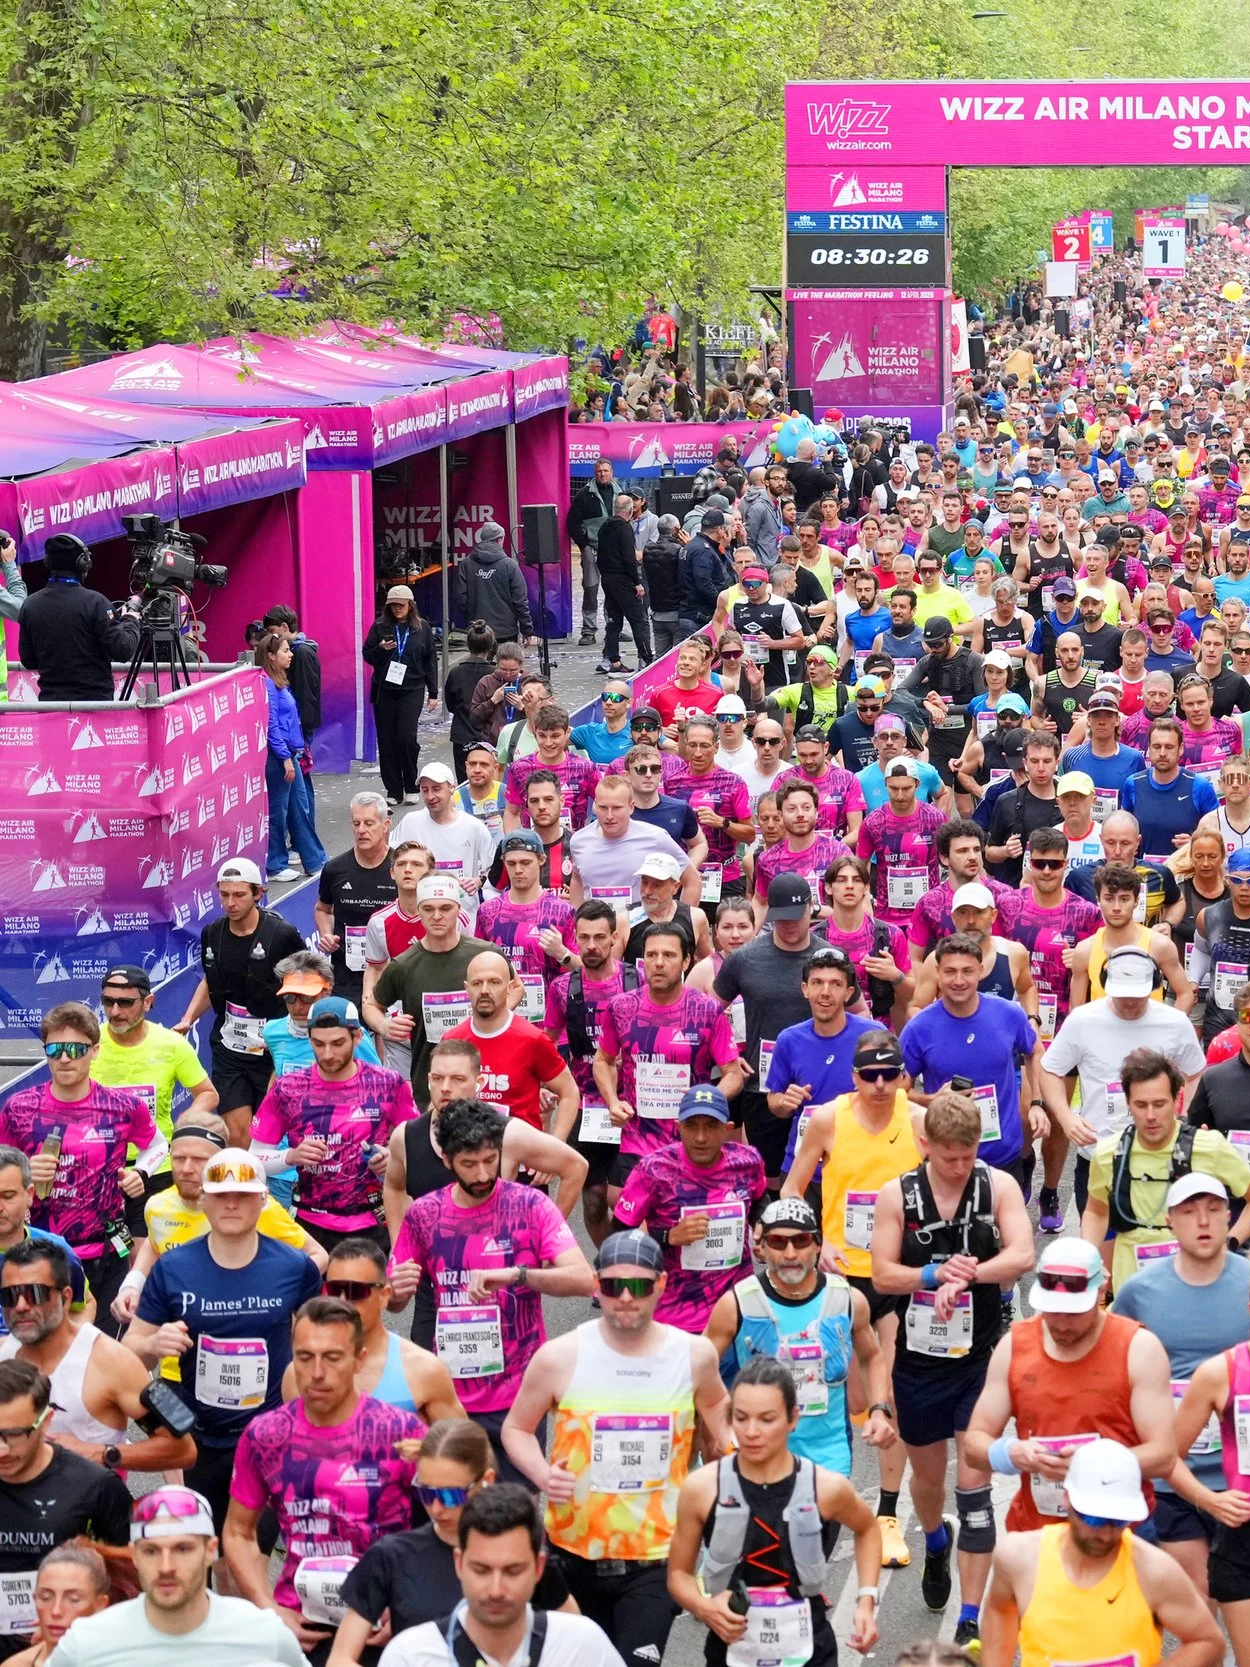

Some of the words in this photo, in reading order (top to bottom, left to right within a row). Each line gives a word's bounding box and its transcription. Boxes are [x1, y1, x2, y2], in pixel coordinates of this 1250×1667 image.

[940, 97, 1024, 120] WIZZ
[1034, 97, 1089, 120] AIR
[1100, 95, 1225, 120] MILANO
[807, 98, 892, 139] WIZZ
[826, 140, 892, 150] wizzair.com
[829, 214, 903, 230] FESTINA
[1092, 226, 1104, 244] 4
[1063, 237, 1080, 260] 2
[1158, 240, 1168, 263] 1
[810, 248, 930, 265] 08:30:26
[793, 291, 809, 299] LIVE
[810, 291, 823, 299] THE
[824, 291, 863, 299] MARATHON
[864, 291, 893, 299] FEELING
[868, 347, 896, 356] WIZZ
[900, 347, 918, 355] AIR
[868, 357, 919, 367] MILANO
[569, 451, 600, 459] ILANO
[673, 450, 713, 458] MILANO
[383, 506, 442, 524] WIZZ
[453, 505, 494, 522] AIR
[475, 568, 496, 580] Staff
[512, 946, 524, 956] AIR
[1031, 952, 1044, 962] AIR
[432, 1009, 451, 1019] CHRISTEN
[452, 1008, 467, 1017] AUGUST
[442, 1018, 458, 1027] 12401
[651, 1053, 665, 1064] AIR
[327, 1134, 342, 1145] AIR
[59, 1154, 74, 1166] AIR
[710, 1226, 732, 1238] EDUARDO
[705, 1238, 723, 1249] 3003
[248, 1295, 282, 1309] Place
[445, 1330, 462, 1342] ENRICO
[462, 1329, 490, 1341] FRANCESCO
[929, 1327, 947, 1336] 3220
[459, 1343, 477, 1353] 5359
[221, 1363, 240, 1374] OLIVER
[219, 1375, 241, 1386] 15016
[619, 1441, 645, 1452] MICHAEL
[311, 1498, 330, 1514] AIR
[8, 1593, 31, 1606] 5703
[759, 1630, 780, 1644] 1224
